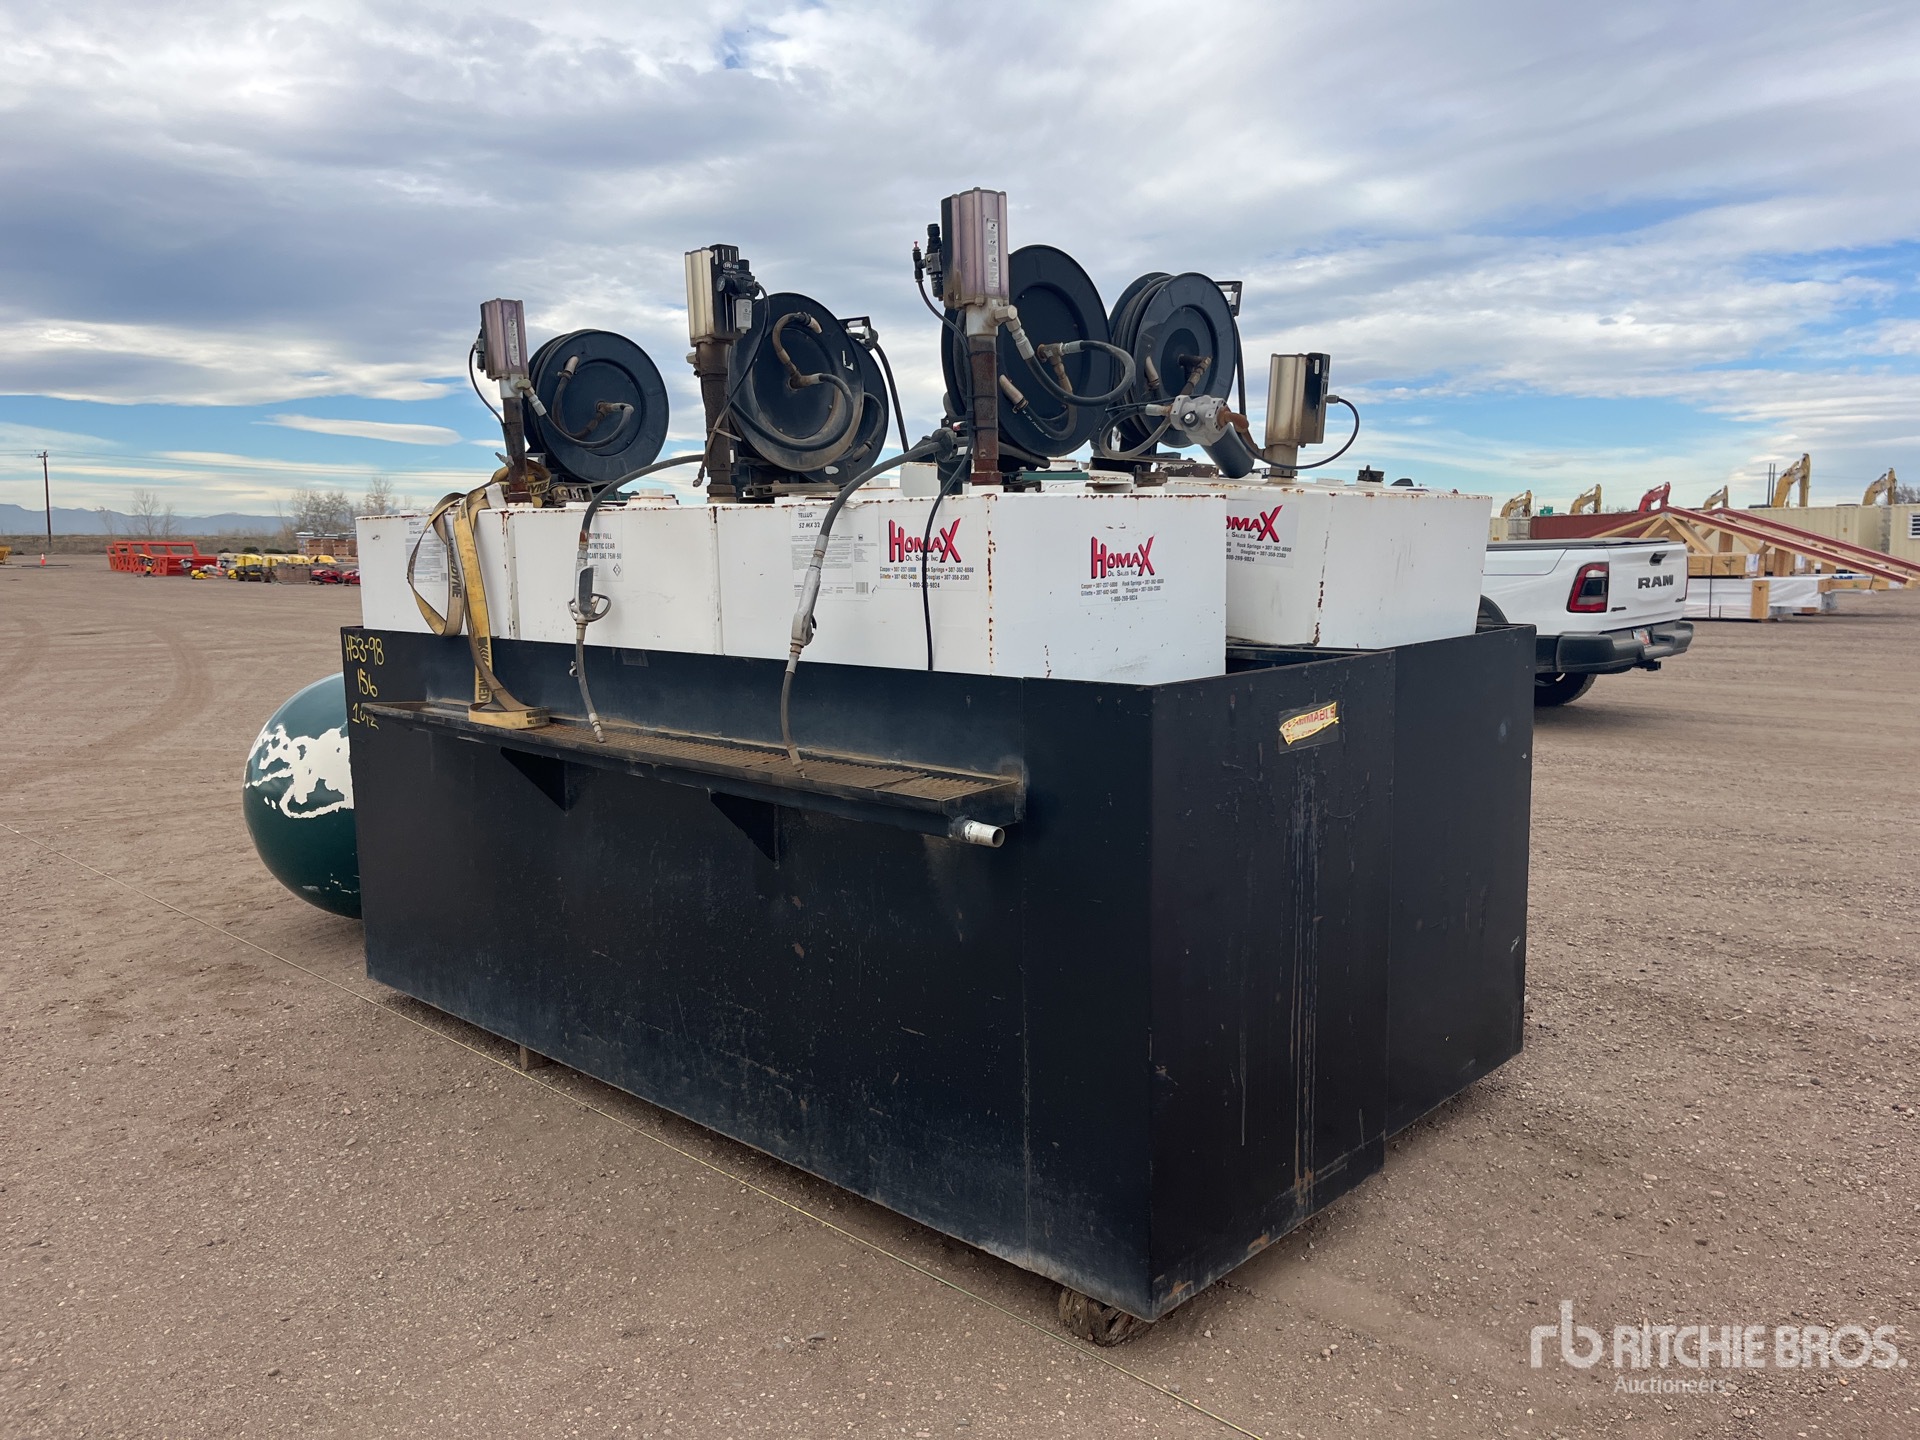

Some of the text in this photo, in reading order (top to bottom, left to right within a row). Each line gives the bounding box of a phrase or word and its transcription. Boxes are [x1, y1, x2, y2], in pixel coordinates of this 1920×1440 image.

[1226, 504, 1283, 543] OMAX
[1638, 575, 1674, 589] RAM
[357, 668, 378, 697] 156
